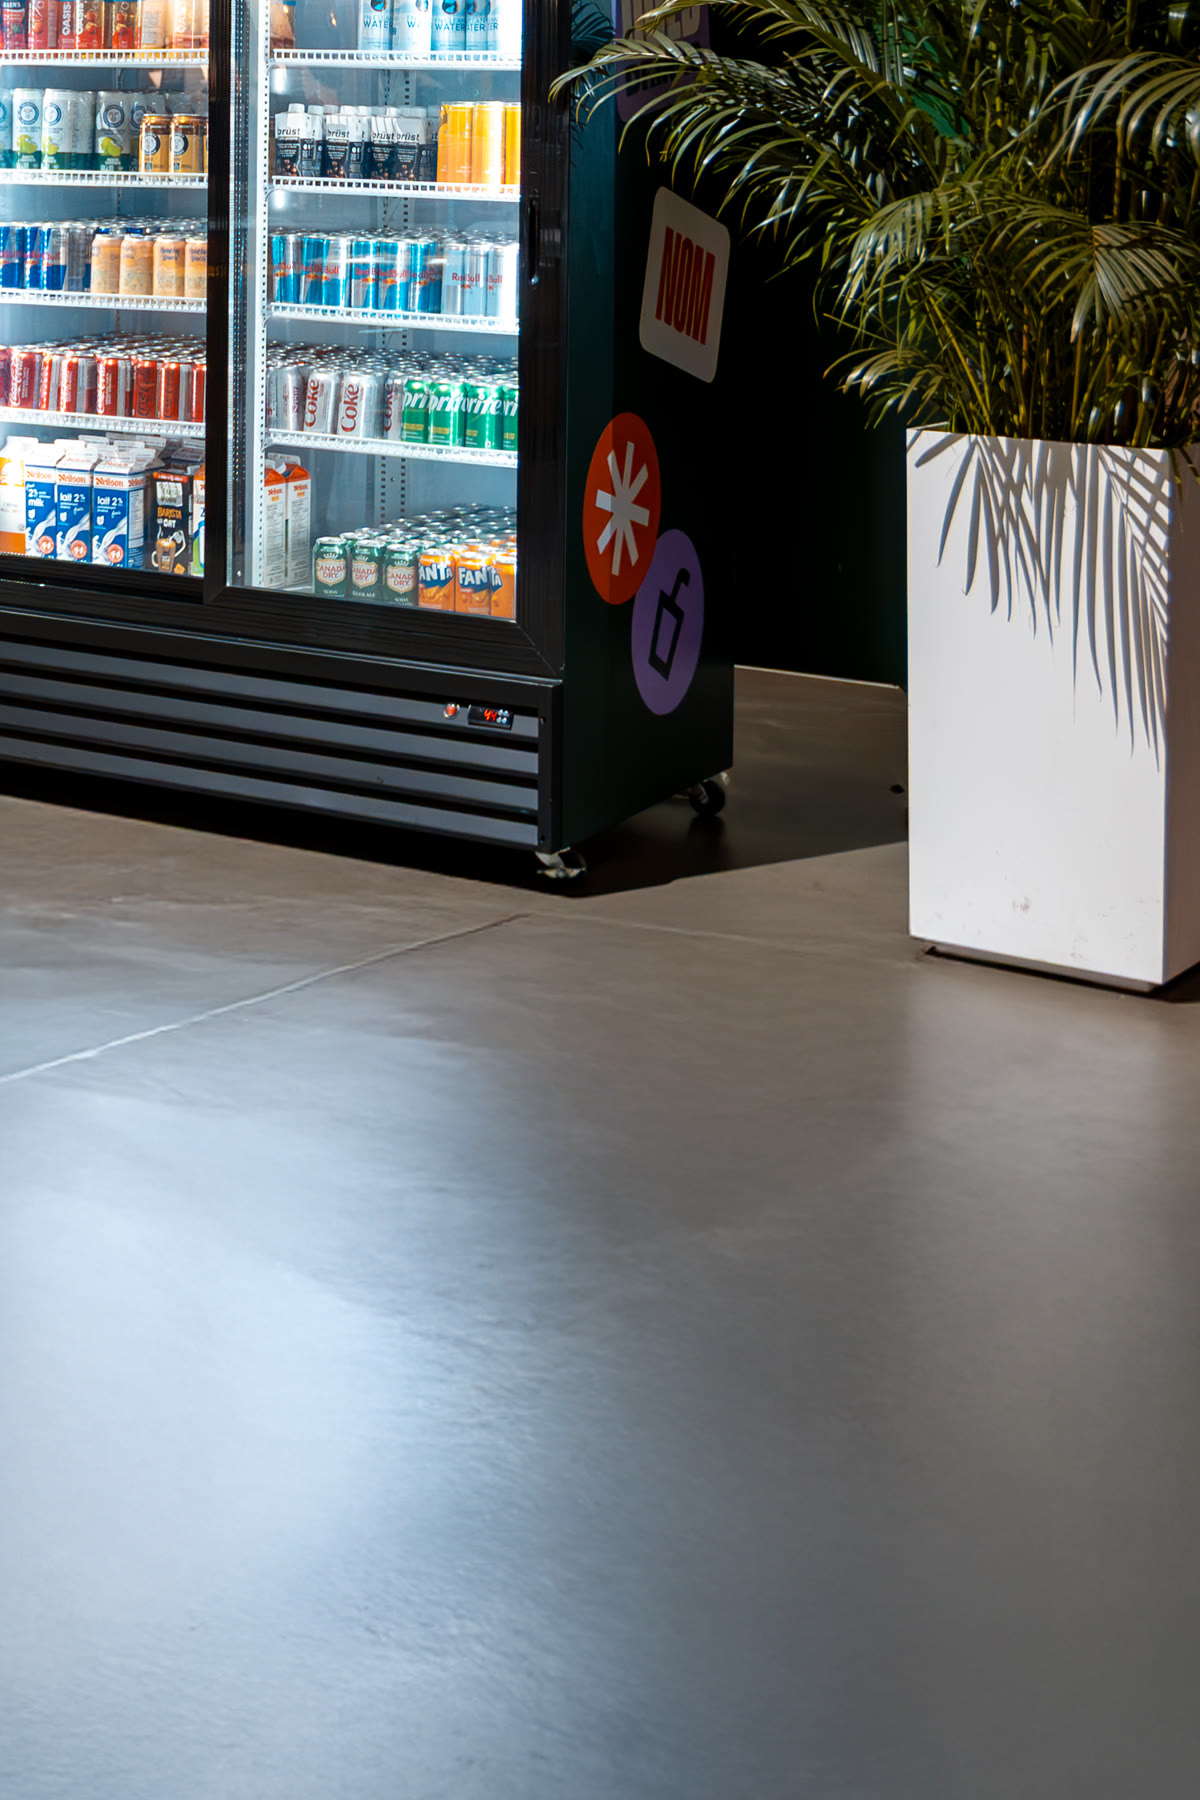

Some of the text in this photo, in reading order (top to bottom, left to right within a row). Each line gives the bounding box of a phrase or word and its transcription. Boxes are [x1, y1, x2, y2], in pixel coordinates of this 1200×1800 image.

[655, 225, 716, 346] NOM
[304, 379, 320, 428] Coke
[340, 383, 360, 433] Coke
[58, 473, 86, 484] Neilson
[95, 477, 124, 488] Neilson
[60, 492, 72, 502] lait
[97, 496, 110, 506] lait
[27, 499, 45, 507] milk
[157, 507, 182, 519] BARISTA
[163, 519, 177, 528] OAT
[418, 563, 454, 582] ANTA
